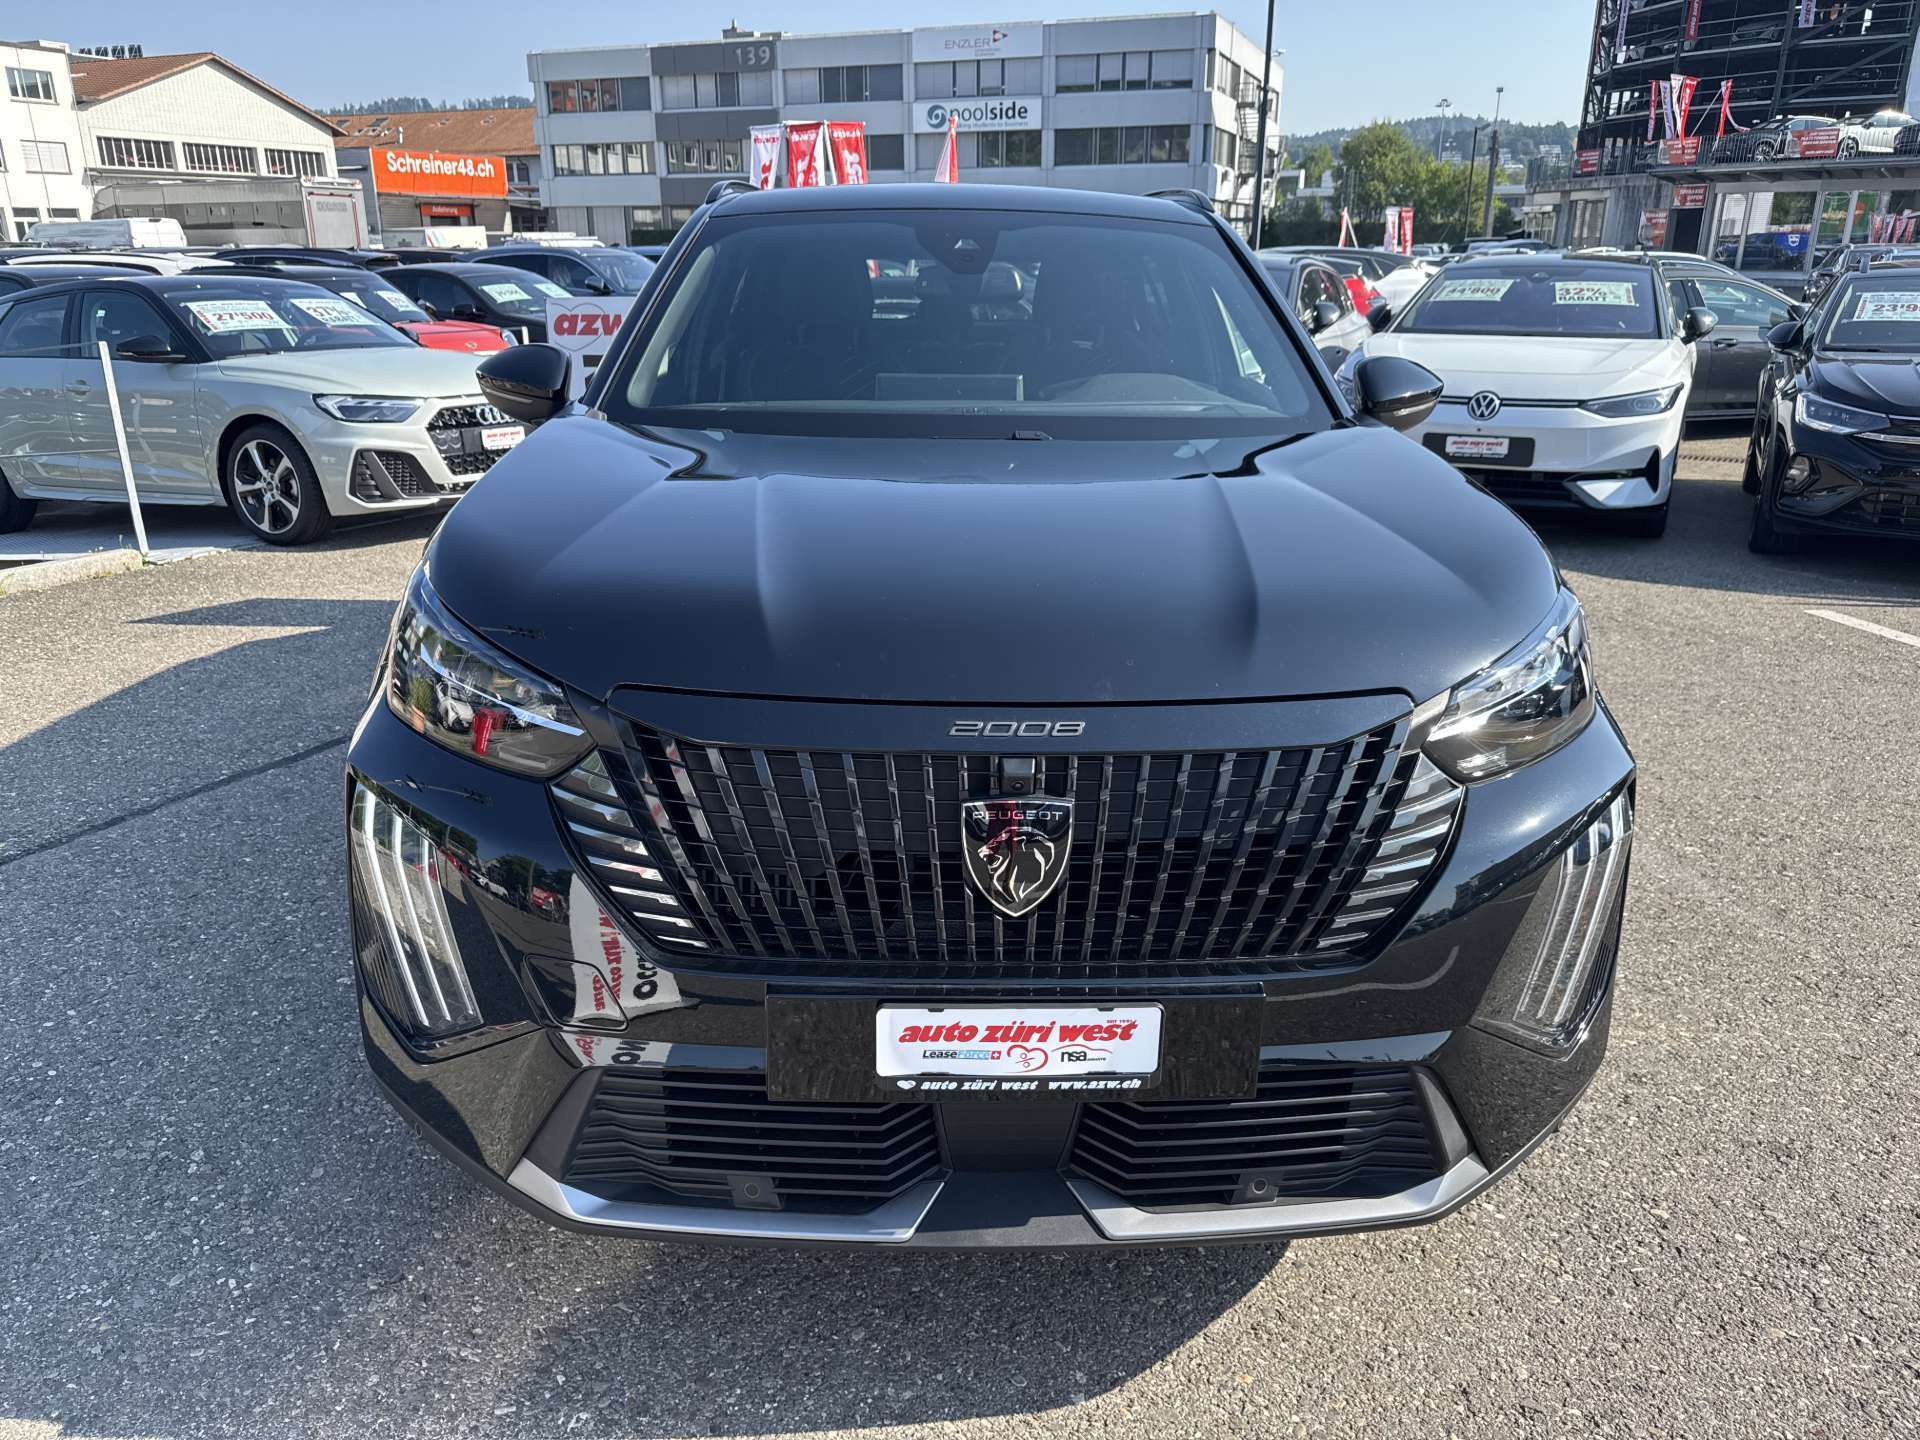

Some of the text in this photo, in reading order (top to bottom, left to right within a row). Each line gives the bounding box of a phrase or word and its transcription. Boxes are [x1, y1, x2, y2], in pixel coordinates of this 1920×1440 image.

[944, 38, 991, 49] ENZLER
[736, 46, 770, 65] 139
[386, 151, 495, 177] Schreiner48.ch
[1558, 288, 1607, 296] 32%
[213, 311, 274, 322] 27'500
[554, 314, 622, 336] azw
[949, 721, 1086, 737] 2008
[973, 810, 1063, 820] PEUGEOT
[899, 1020, 1139, 1043] auto züri west
[922, 1050, 990, 1060] LeaseForce
[1061, 1050, 1086, 1063] nsa
[921, 1079, 1142, 1090] auto züri west www.azw.ch
